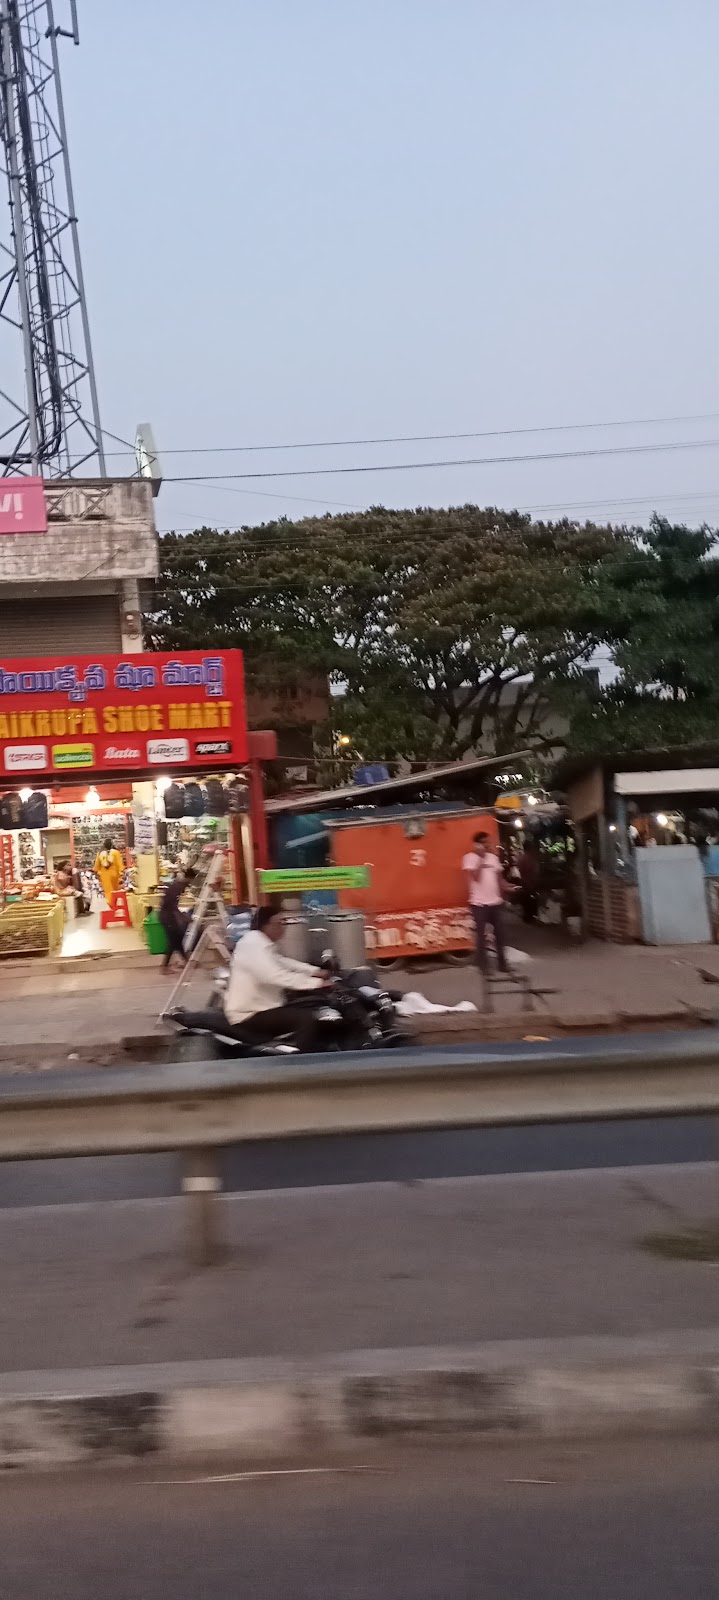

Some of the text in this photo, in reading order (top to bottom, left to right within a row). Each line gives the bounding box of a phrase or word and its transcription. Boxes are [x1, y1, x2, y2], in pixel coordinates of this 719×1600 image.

[102, 704, 164, 733] SHOE
[168, 701, 233, 730] MART
[103, 746, 141, 759] Bata
